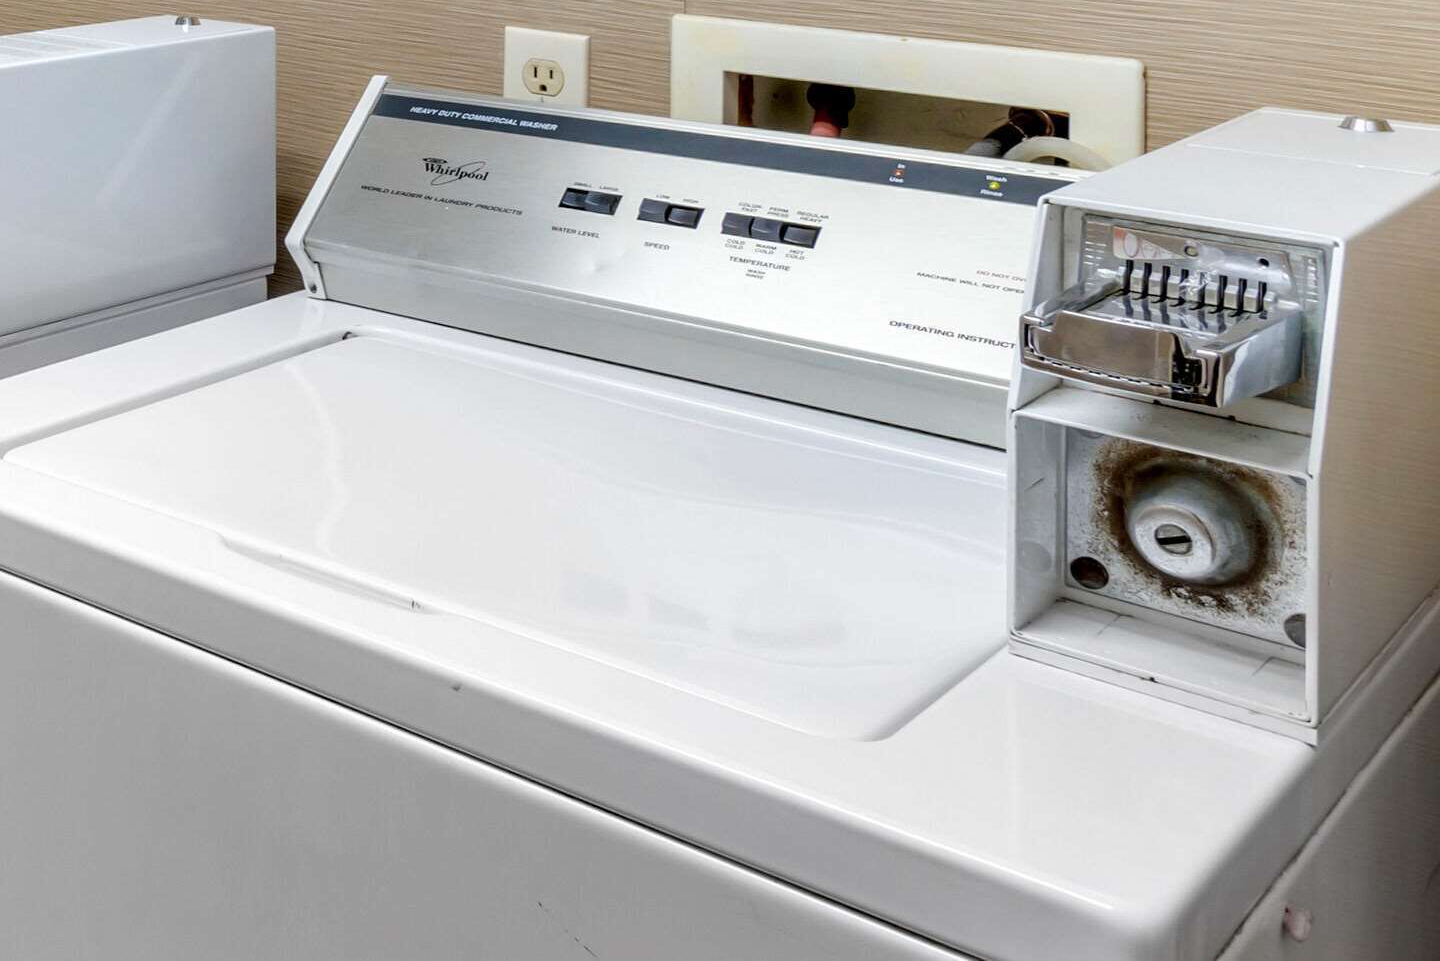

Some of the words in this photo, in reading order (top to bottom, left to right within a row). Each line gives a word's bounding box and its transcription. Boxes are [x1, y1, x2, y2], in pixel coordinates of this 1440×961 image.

[410, 106, 440, 116] HEAVY
[438, 110, 462, 118] DUTY
[462, 113, 518, 126] COMMERCIAL
[519, 120, 558, 131] WASHER
[424, 162, 489, 182] Whirlpool
[361, 185, 388, 194] WORLD
[391, 189, 423, 199] LEADER
[434, 197, 475, 208] LAUNDRY
[475, 204, 523, 216] PRODUCTS
[552, 226, 577, 235] WATER
[578, 230, 601, 238] LEVEL
[644, 241, 670, 251] SPEED
[729, 256, 791, 271] TEMPERATURE
[917, 272, 957, 283] MACHINE
[960, 279, 979, 287] WILL
[982, 283, 1001, 291] NOT
[889, 320, 955, 338] OPERATING
